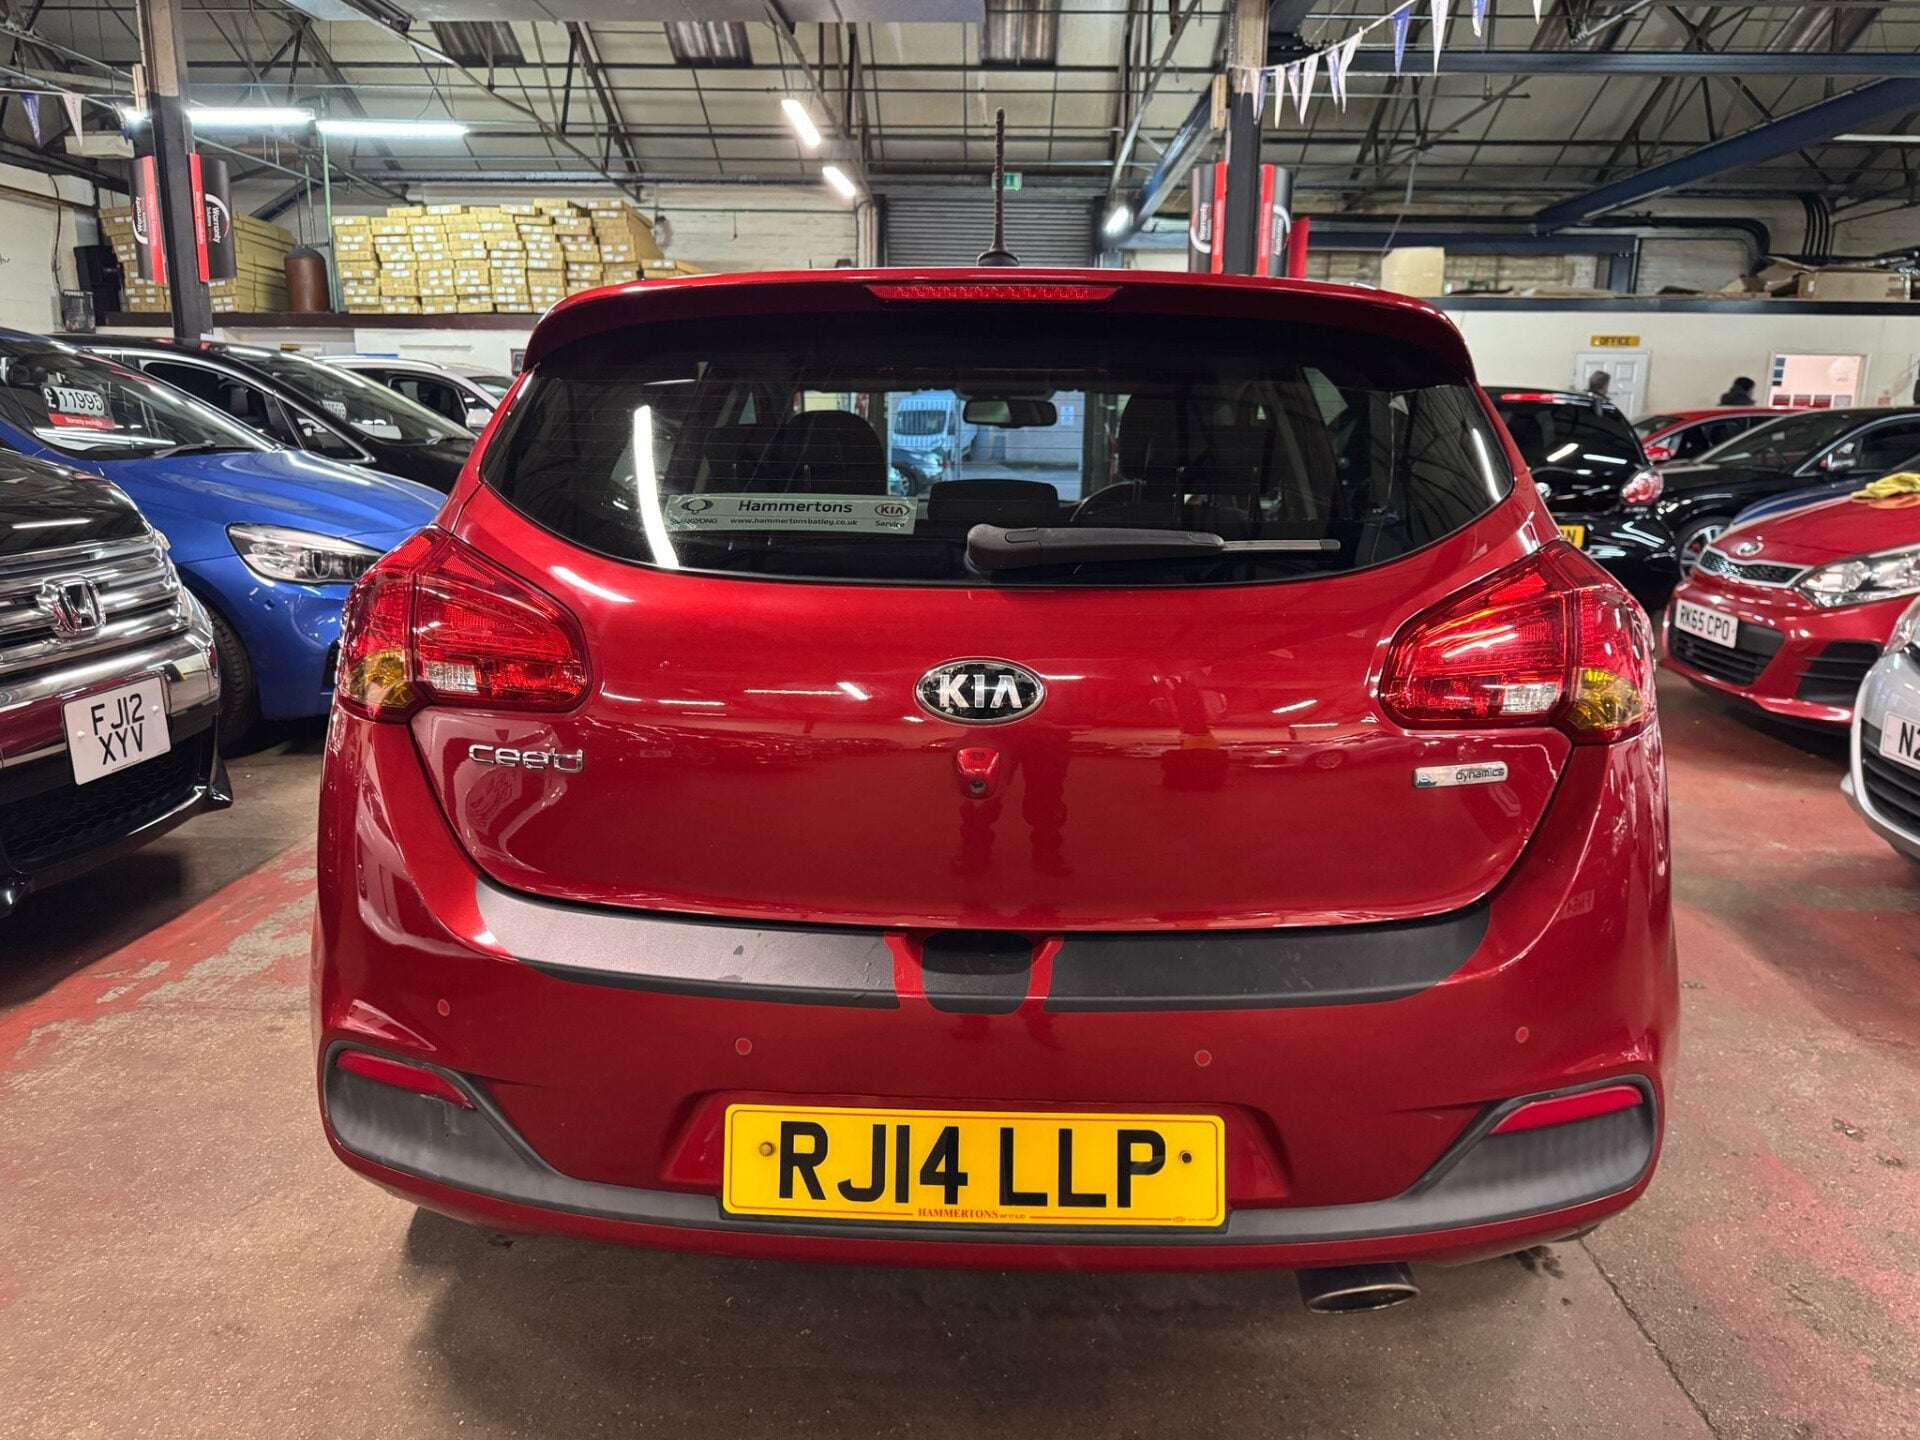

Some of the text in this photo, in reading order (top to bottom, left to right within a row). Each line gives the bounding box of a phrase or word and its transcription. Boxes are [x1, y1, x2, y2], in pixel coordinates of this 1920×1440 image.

[738, 501, 854, 513] Hammertons
[881, 505, 903, 515] KIA
[730, 518, 858, 526] www.hammertonsbatley.co.uk
[939, 674, 1022, 708] KIA
[91, 693, 144, 736] FJ12
[98, 723, 143, 765] XYV
[1456, 767, 1505, 783] dynamics
[779, 1120, 1166, 1208] RJ14 LLP
[918, 1208, 999, 1218] HAMMERTONS
